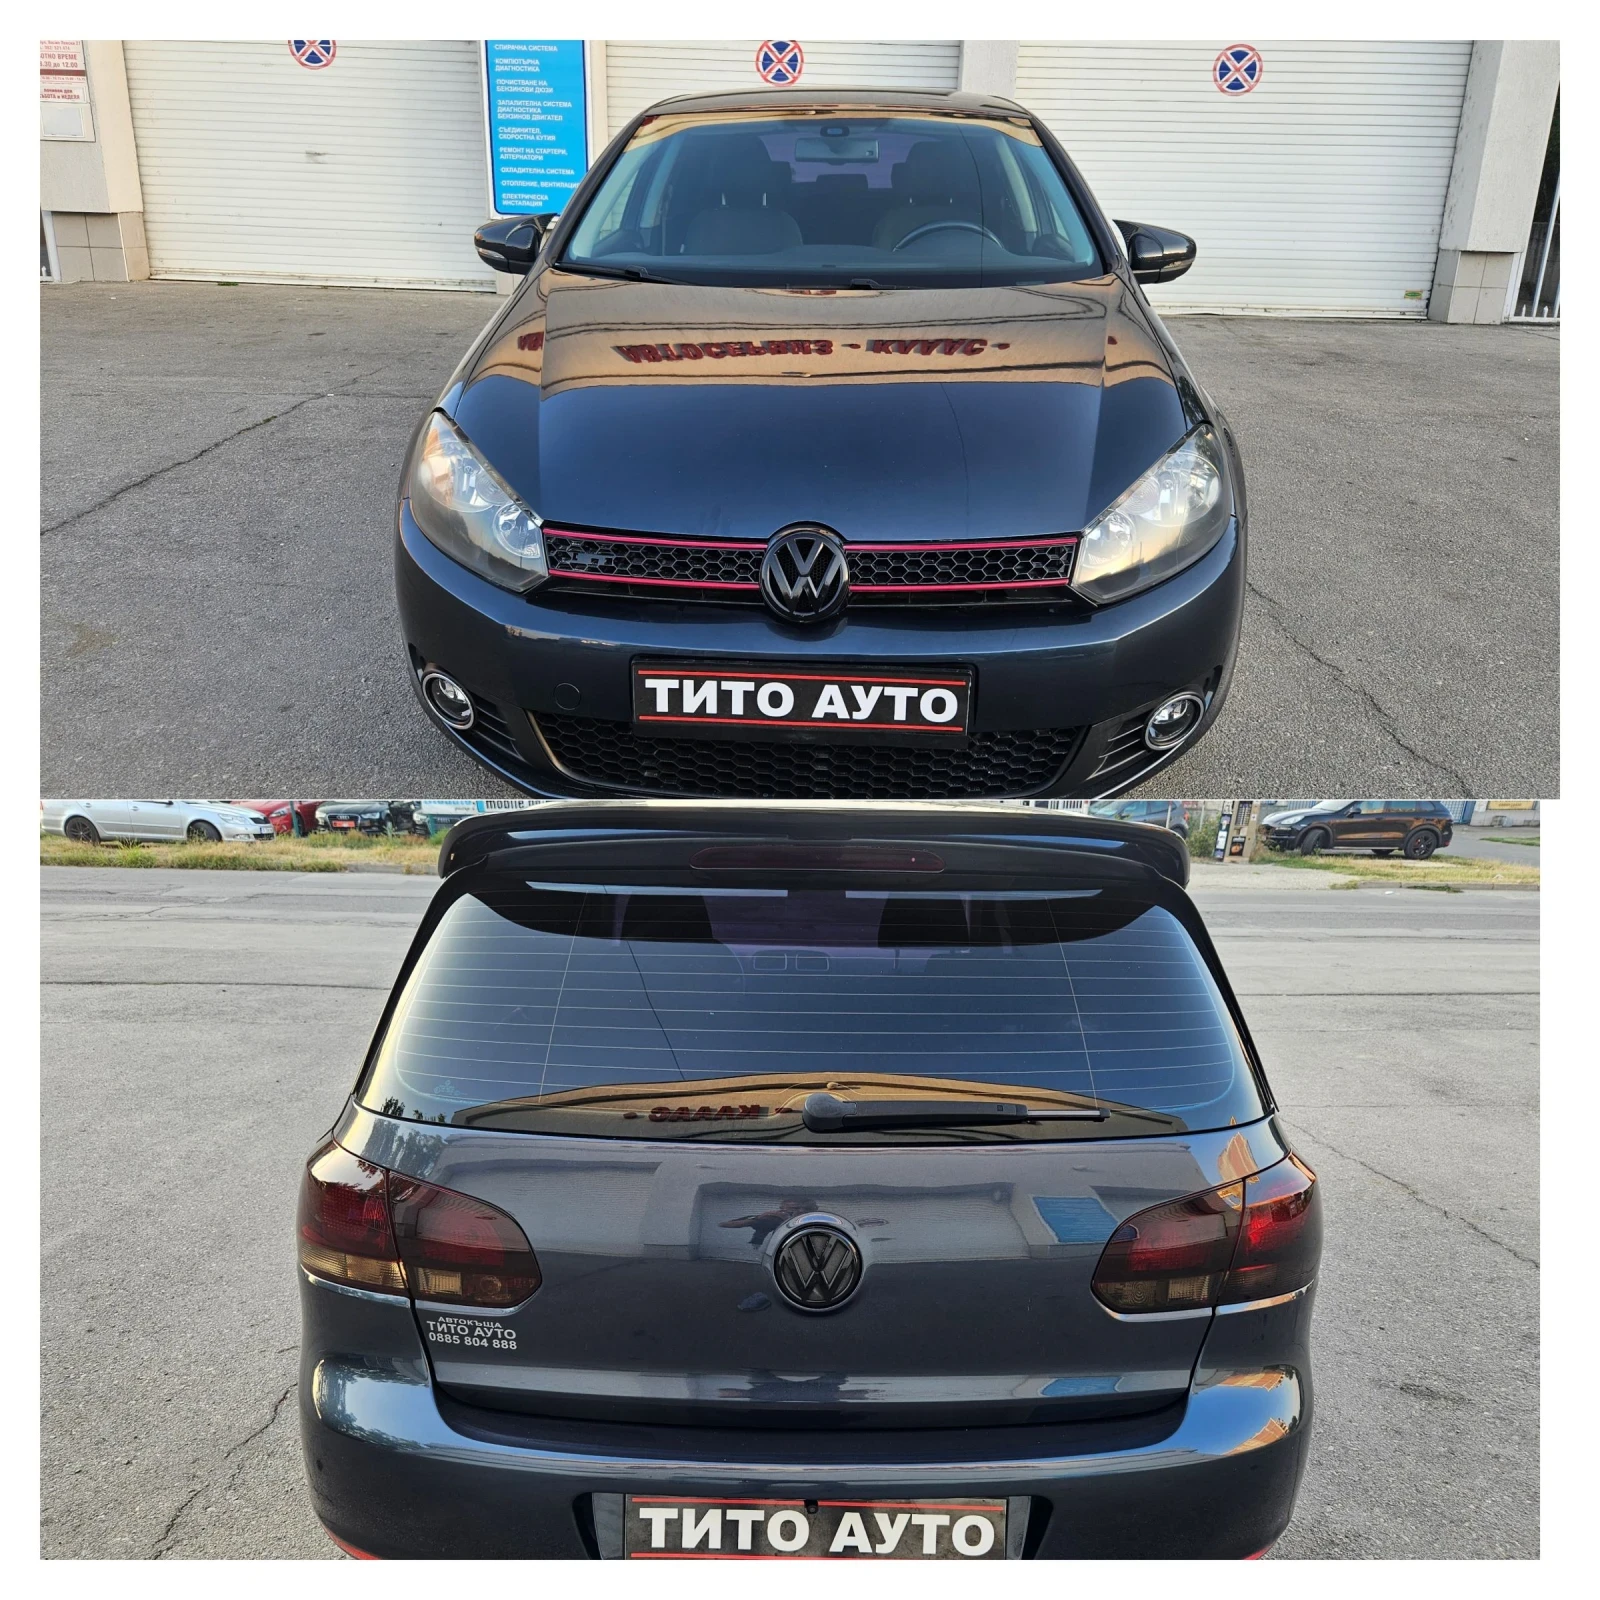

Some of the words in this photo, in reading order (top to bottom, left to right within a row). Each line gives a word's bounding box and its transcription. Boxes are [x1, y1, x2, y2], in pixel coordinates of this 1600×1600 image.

[645, 678, 795, 718] ТИТО
[811, 684, 959, 723] АУТО
[426, 1320, 469, 1335] ТИТО
[474, 1327, 517, 1340] АУТО
[438, 1316, 503, 1328] АВТОКЪЩА
[428, 1332, 461, 1344] 0885
[464, 1336, 489, 1348] 804
[492, 1339, 517, 1350] 888
[639, 1507, 810, 1552] ТИТО
[829, 1512, 995, 1556] АУТО
